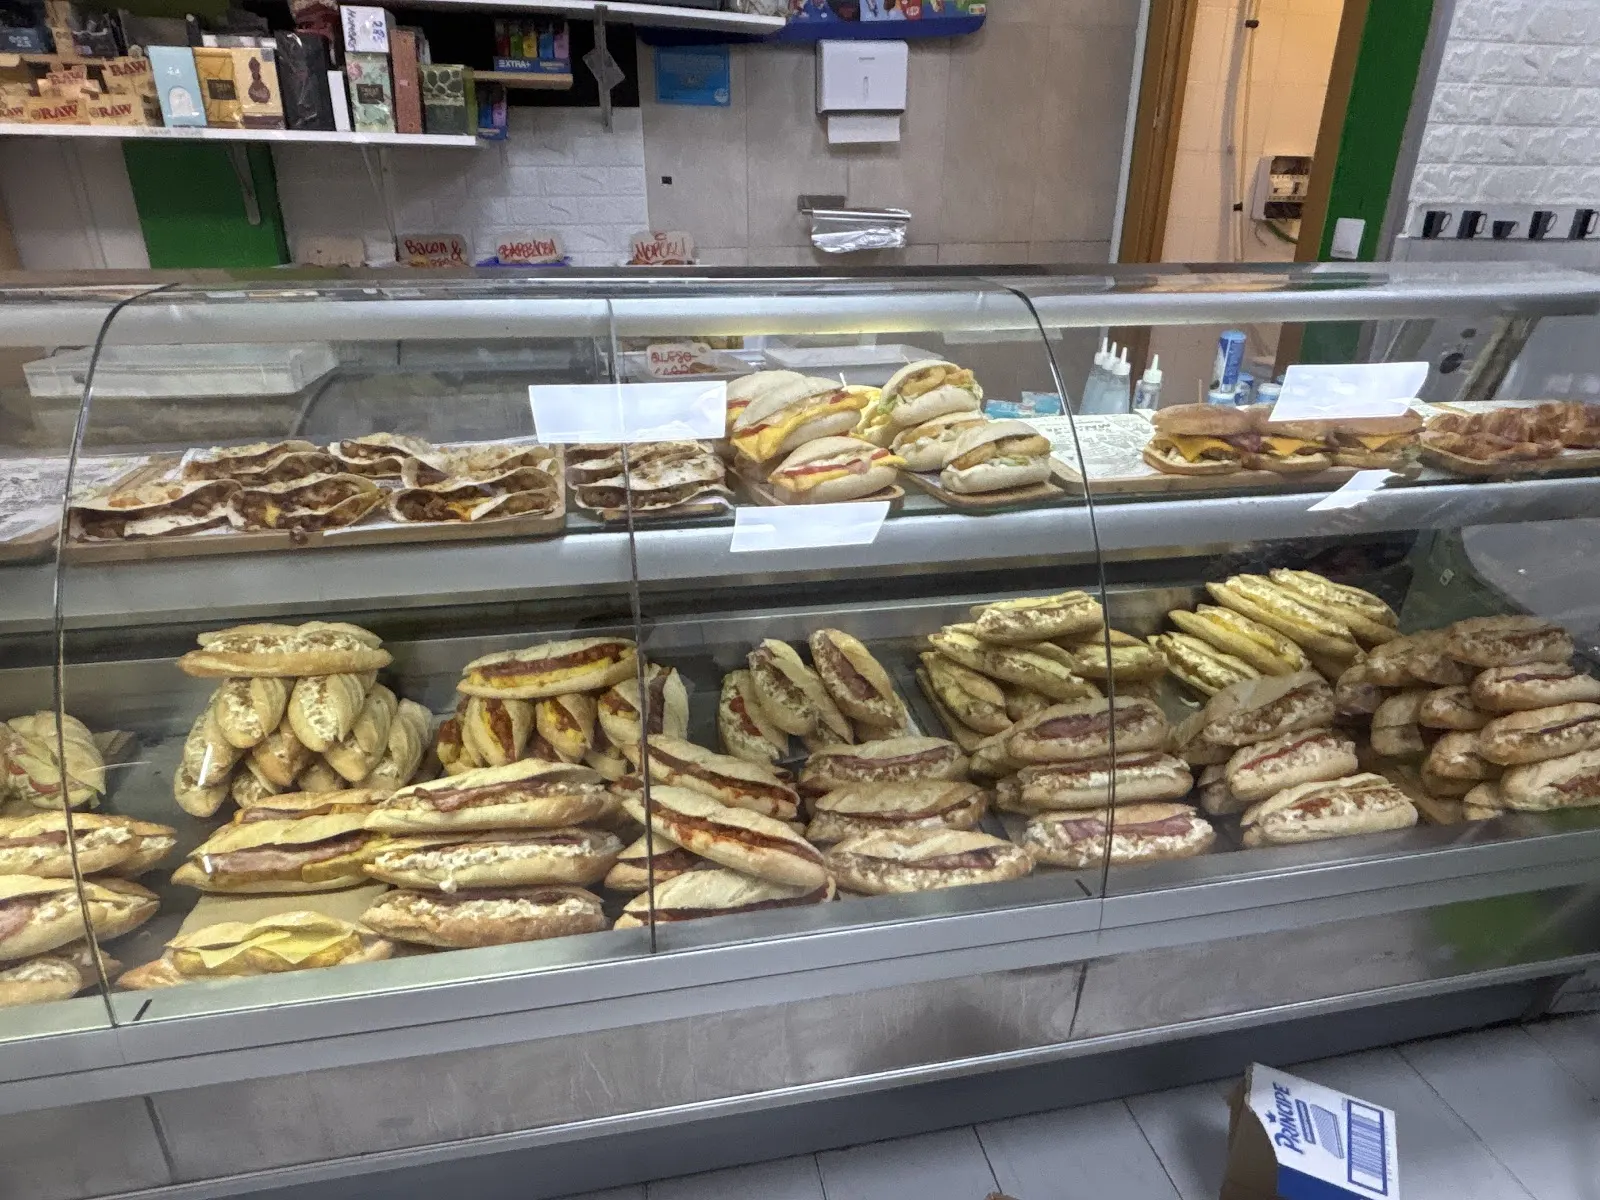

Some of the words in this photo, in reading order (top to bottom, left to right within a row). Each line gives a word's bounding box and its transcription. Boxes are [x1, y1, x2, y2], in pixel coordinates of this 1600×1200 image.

[109, 60, 147, 76] RAW
[39, 104, 78, 119] RAW
[97, 104, 132, 118] RAW
